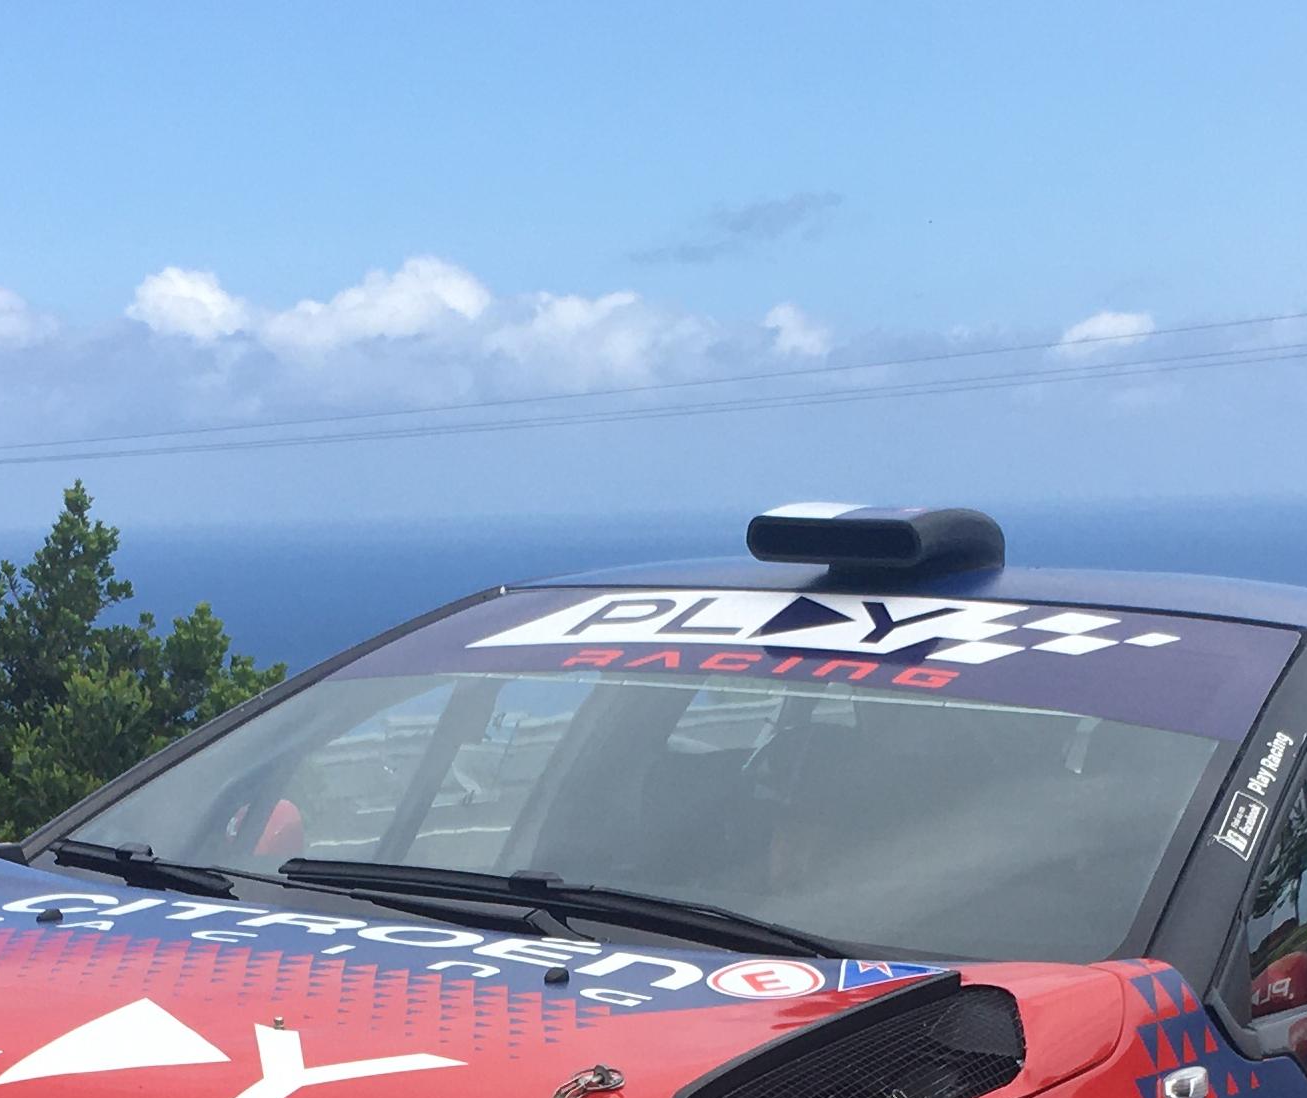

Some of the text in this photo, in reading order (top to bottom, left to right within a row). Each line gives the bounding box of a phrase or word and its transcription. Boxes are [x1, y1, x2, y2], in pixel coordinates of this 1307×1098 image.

[563, 595, 967, 644] PLAY
[562, 649, 961, 688] RACING
[1247, 731, 1293, 796] Play Racing
